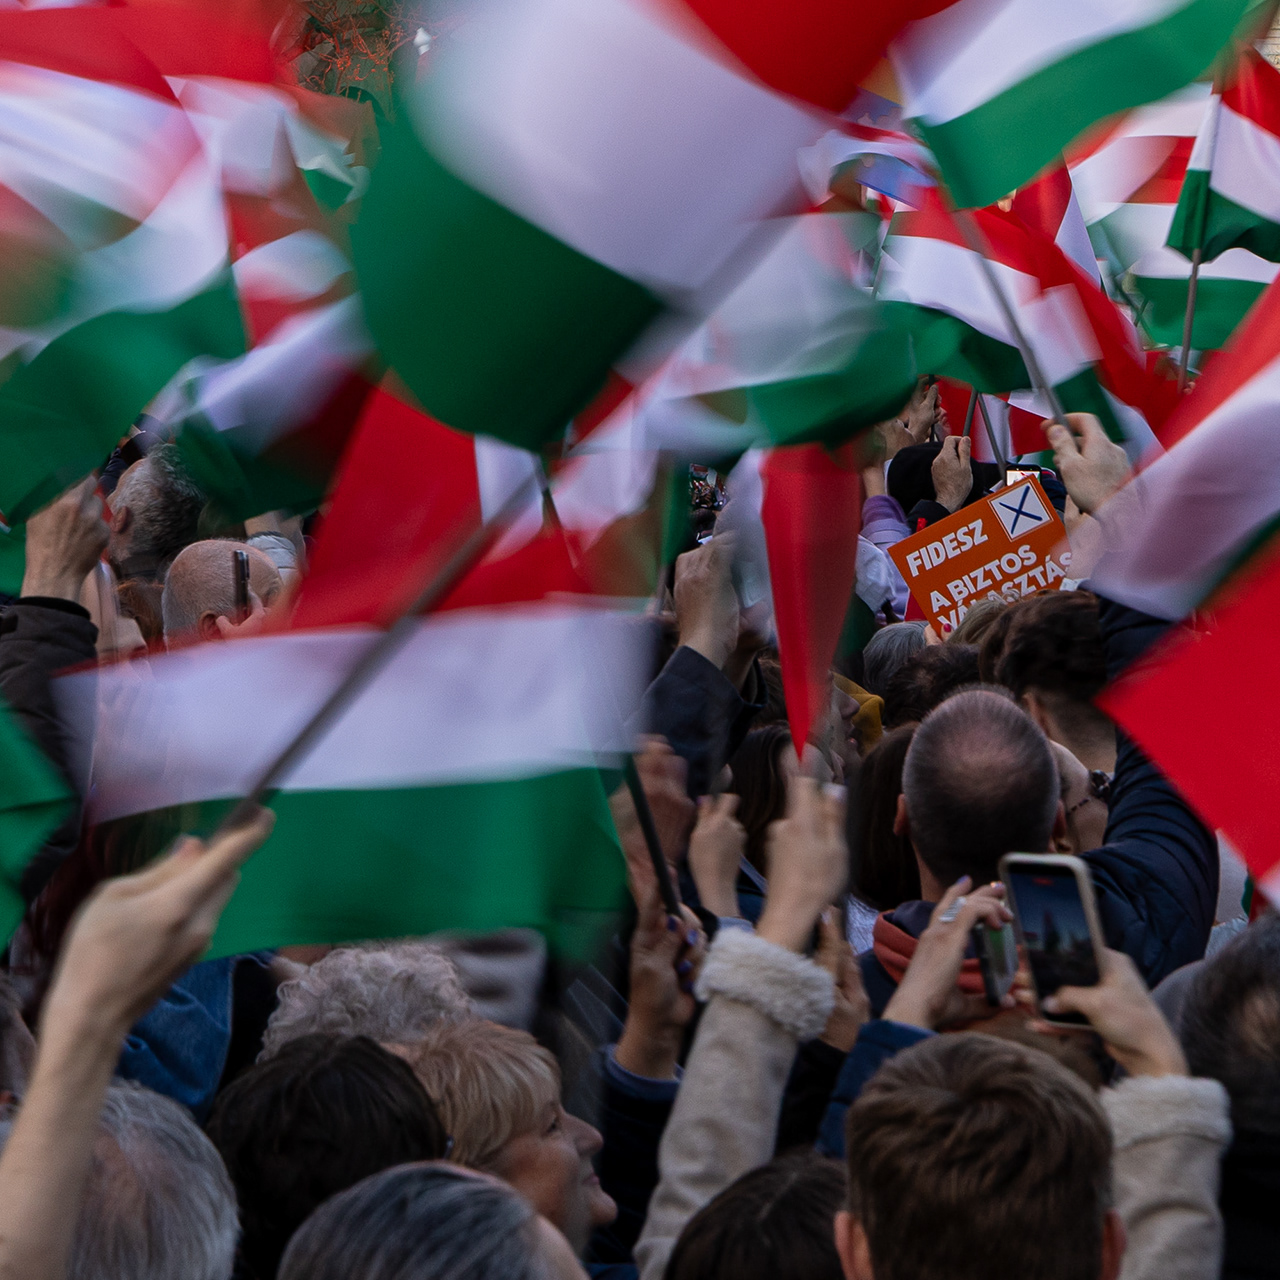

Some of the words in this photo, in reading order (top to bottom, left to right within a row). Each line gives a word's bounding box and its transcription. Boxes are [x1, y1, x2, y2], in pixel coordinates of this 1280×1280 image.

[905, 518, 989, 578] FIDESZ
[929, 589, 952, 614] A
[946, 544, 1038, 602] BIZTOS
[936, 551, 1072, 631] VÁASZTÁS
